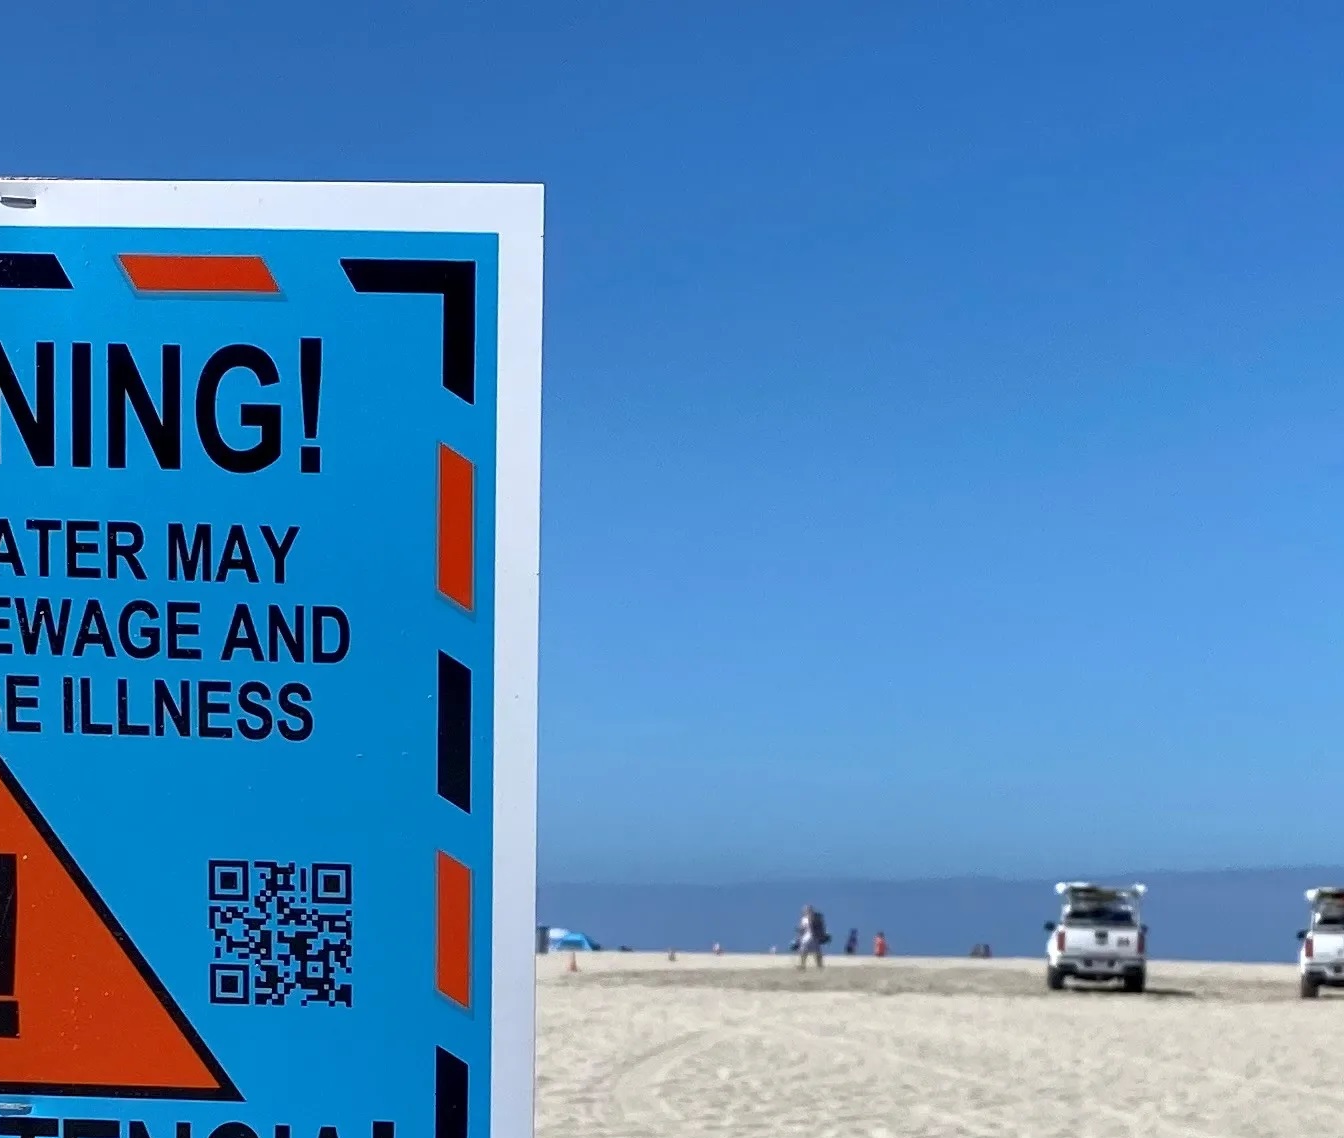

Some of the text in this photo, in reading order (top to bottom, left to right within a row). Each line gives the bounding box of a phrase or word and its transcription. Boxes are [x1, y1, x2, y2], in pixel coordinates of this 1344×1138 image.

[167, 523, 300, 584] MAY
[220, 603, 350, 664] AND
[63, 676, 313, 742] ILLNESS
